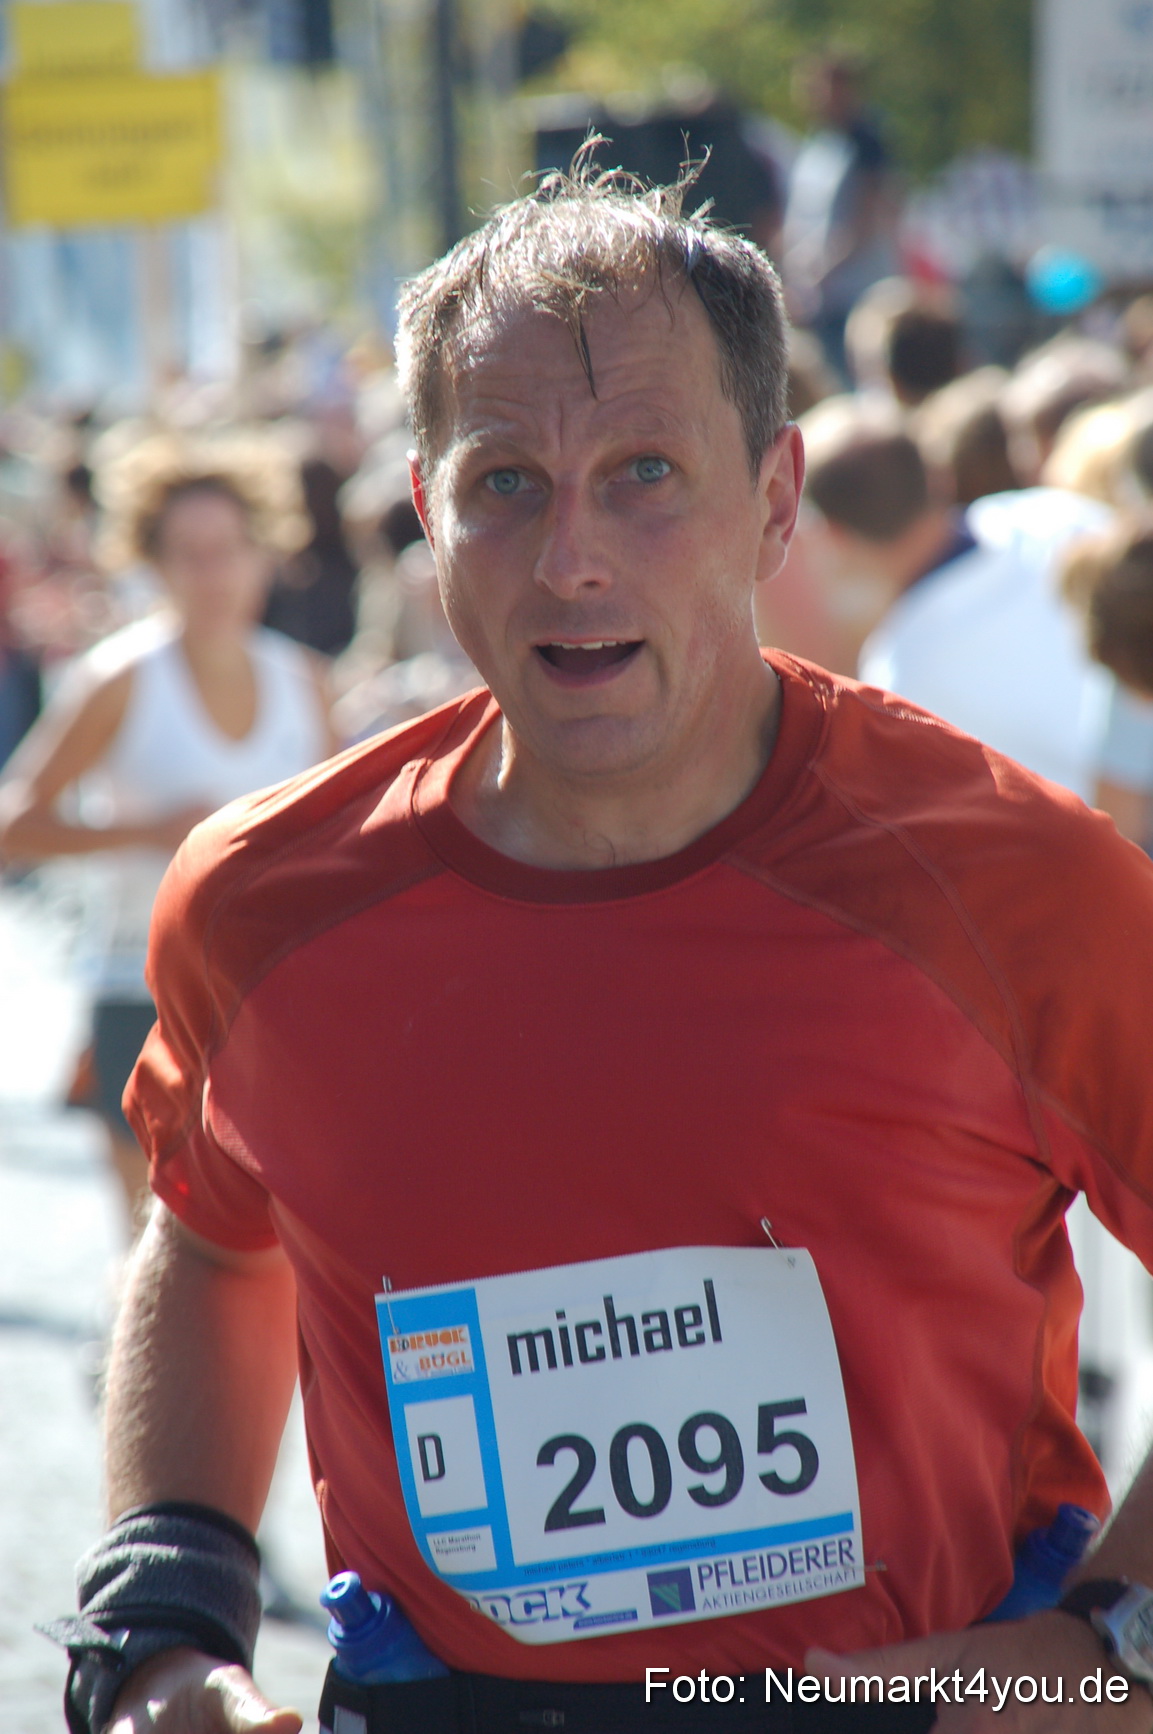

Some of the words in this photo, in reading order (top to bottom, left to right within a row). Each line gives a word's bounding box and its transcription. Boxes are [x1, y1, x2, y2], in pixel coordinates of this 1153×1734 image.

[506, 1279, 723, 1376] michael
[417, 1433, 446, 1482] D
[536, 1397, 820, 1535] 2095
[697, 1536, 856, 1592] PFLEIDERER
[702, 1568, 857, 1611] AKTIENGESELLSCHAFT
